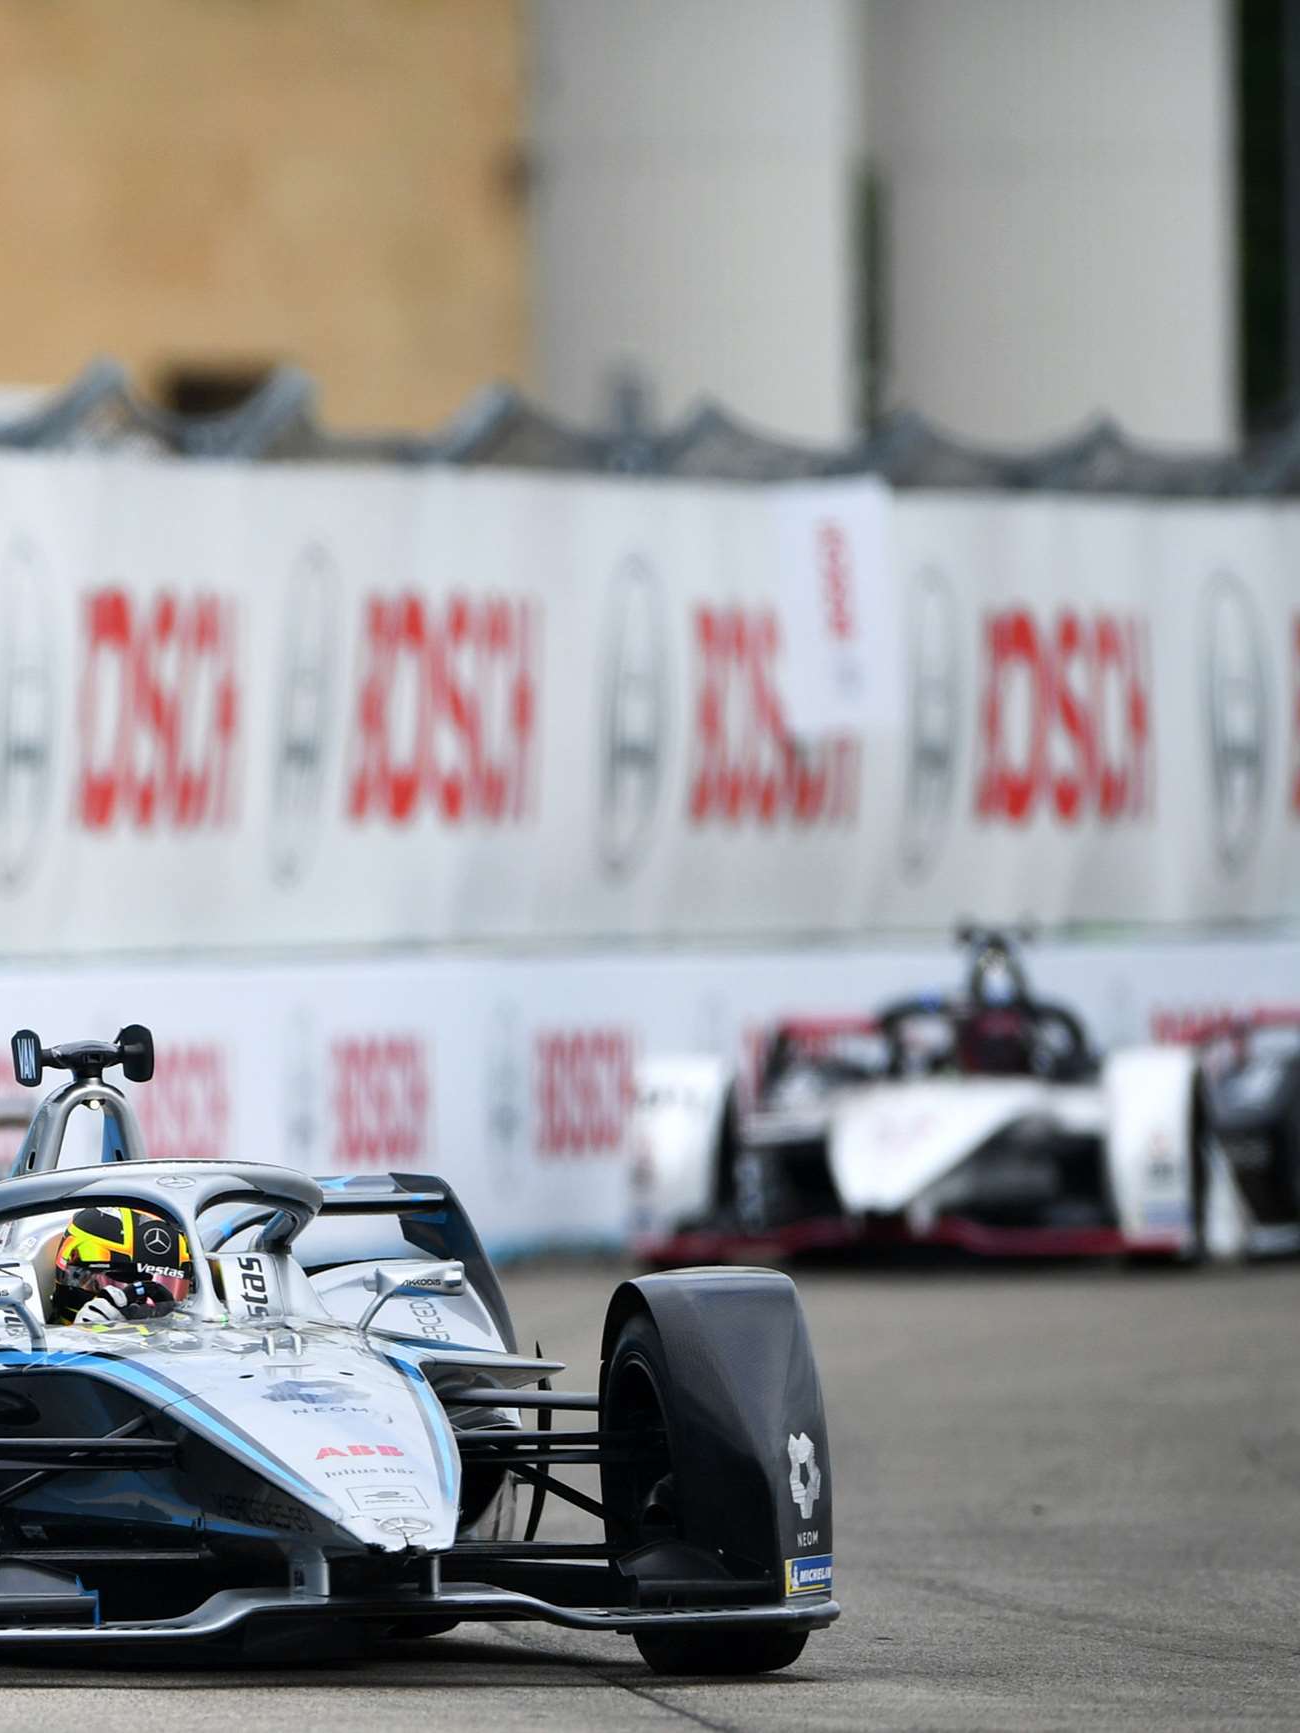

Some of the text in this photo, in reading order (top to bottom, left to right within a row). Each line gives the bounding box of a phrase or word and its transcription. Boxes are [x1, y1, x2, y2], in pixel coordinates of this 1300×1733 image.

[137, 1263, 185, 1279] Vestas
[238, 1257, 269, 1321] stas
[401, 1279, 441, 1288] AKKODIS
[292, 1407, 368, 1415] NEOM
[316, 1445, 404, 1460] ABB
[797, 1530, 819, 1547] NEOM
